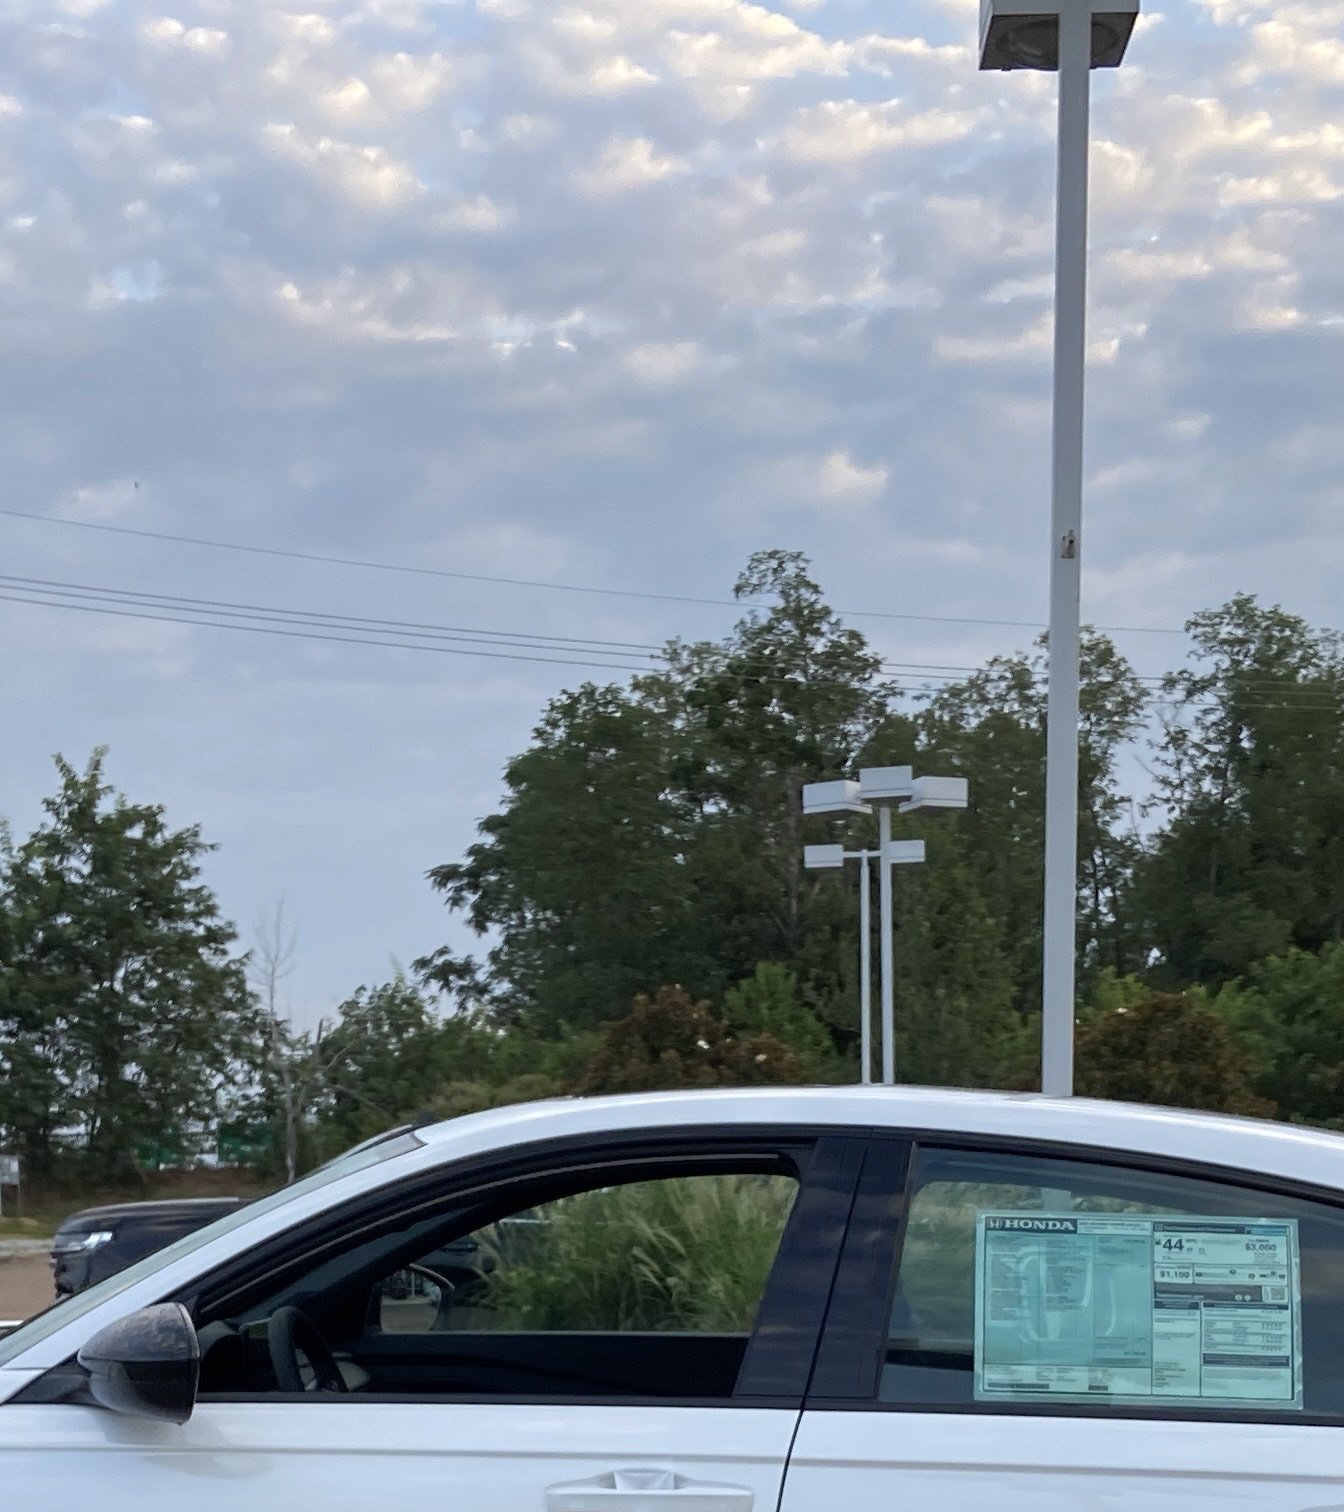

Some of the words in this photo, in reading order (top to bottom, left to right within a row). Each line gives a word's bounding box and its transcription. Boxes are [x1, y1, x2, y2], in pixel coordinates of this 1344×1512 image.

[1005, 1219, 1075, 1231] HONDA
[1162, 1238, 1184, 1251] 44
[1245, 1243, 1276, 1252] $3,000
